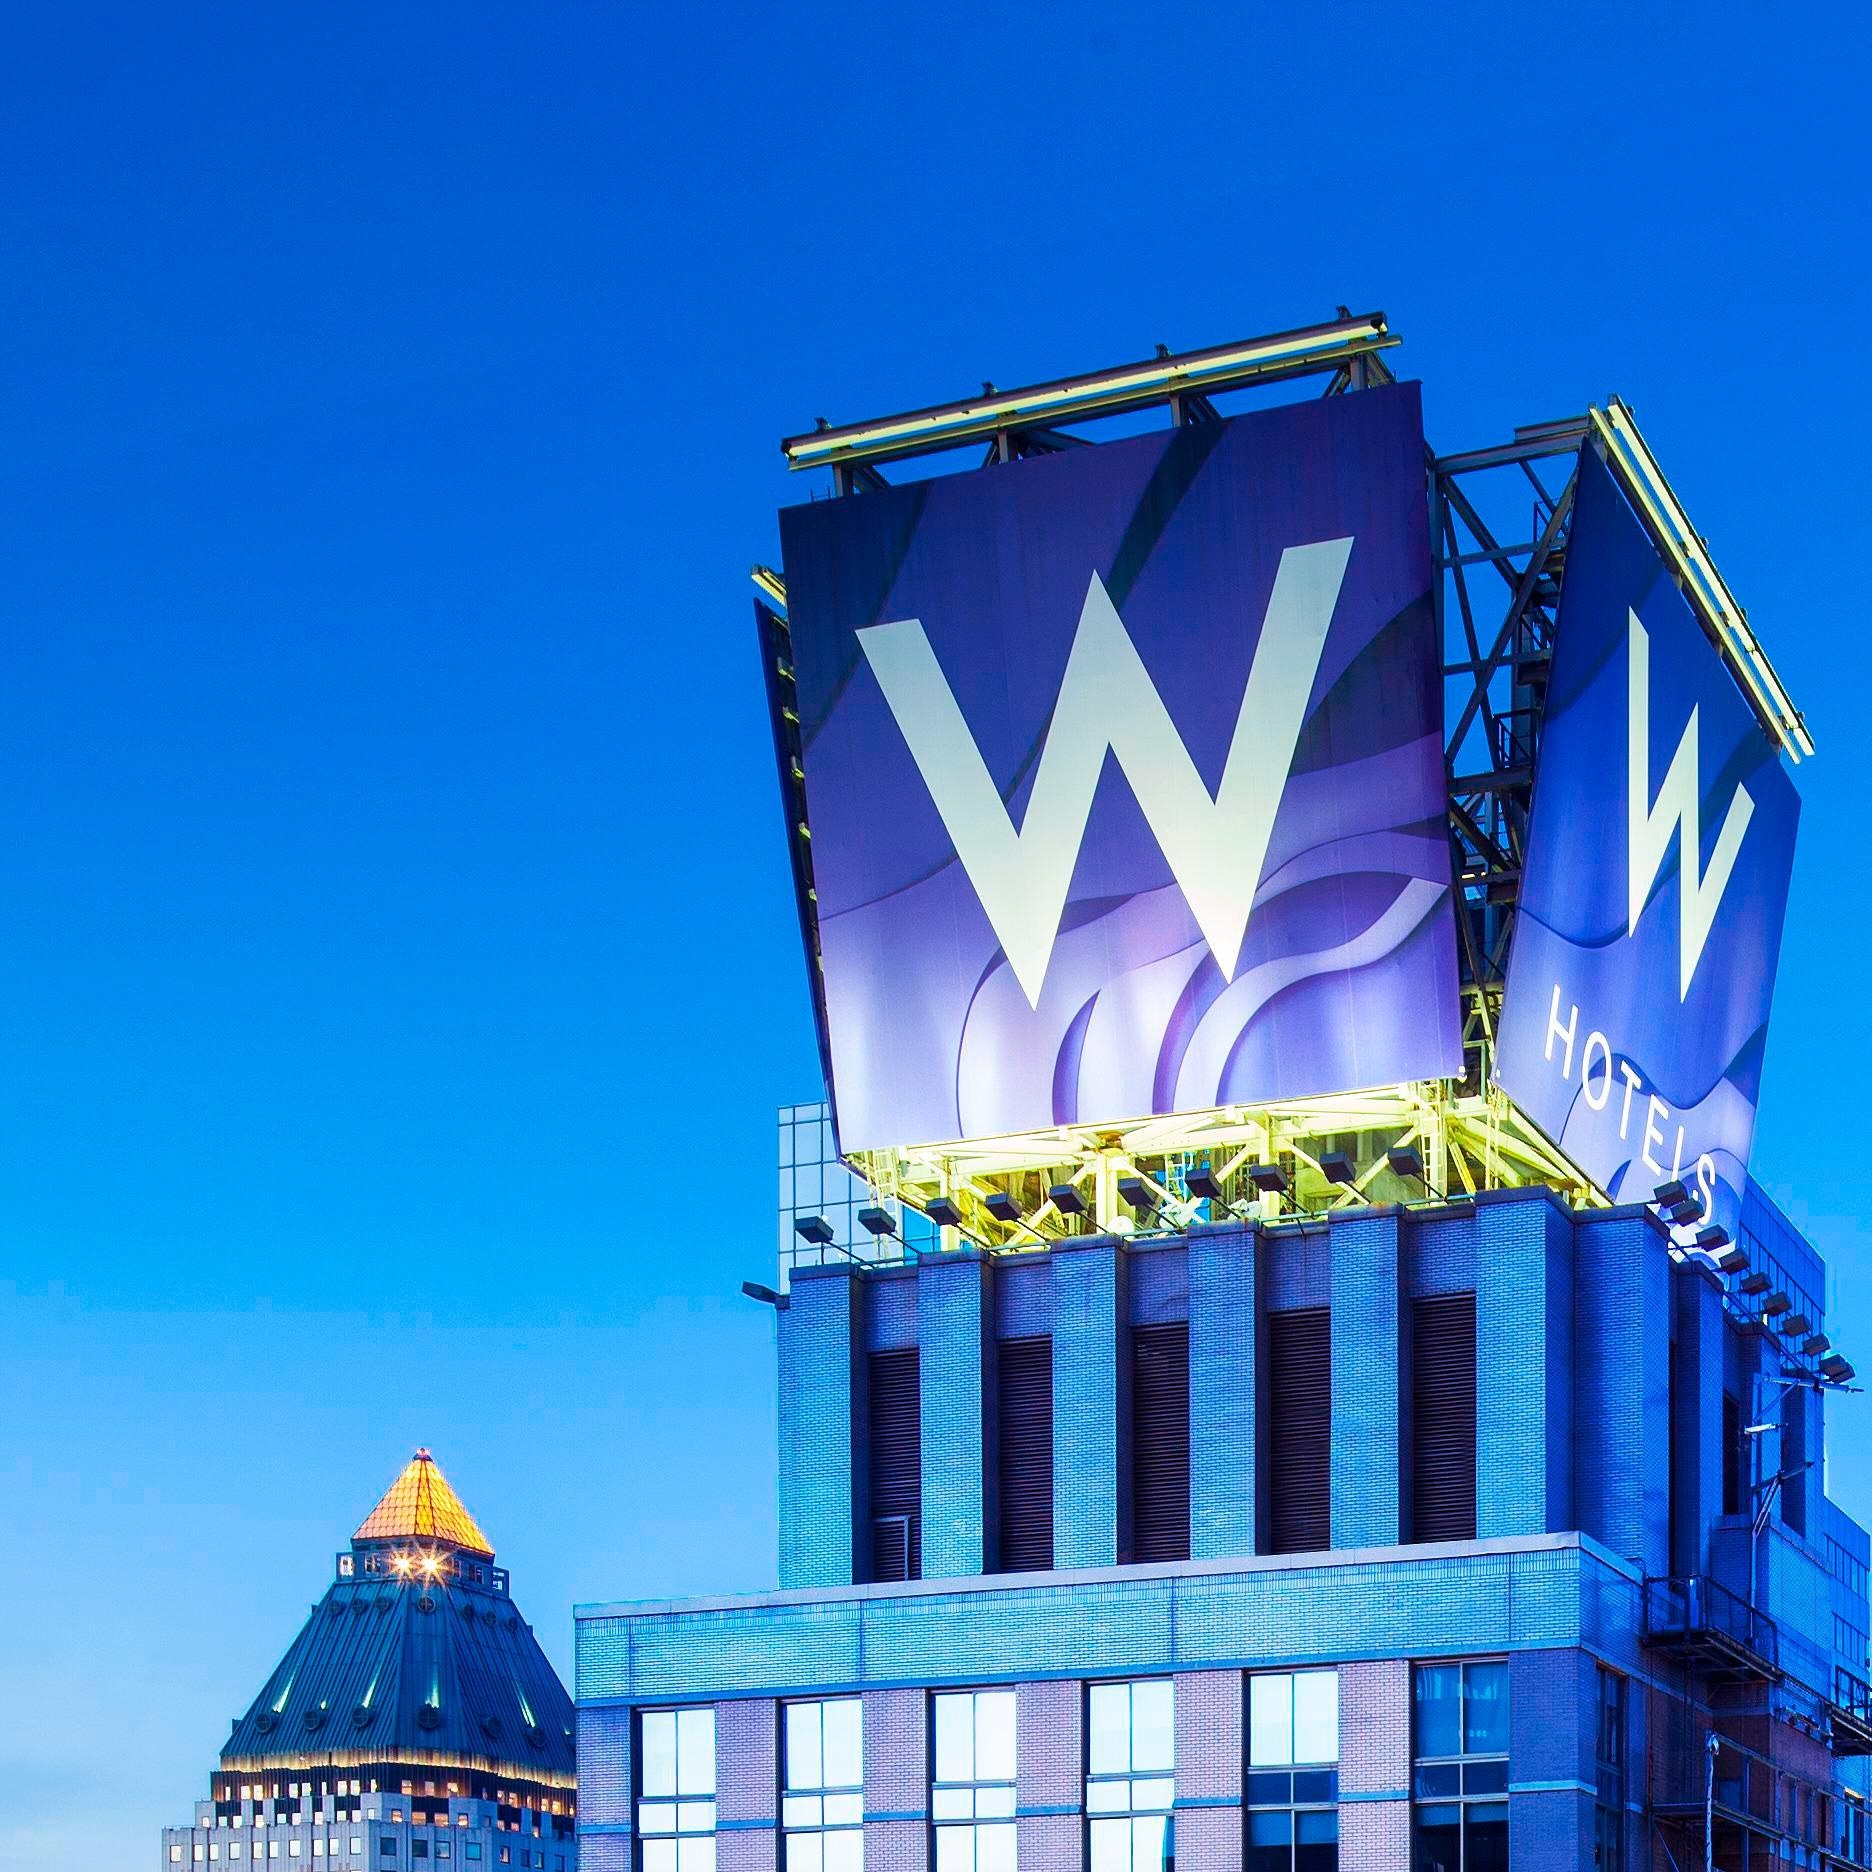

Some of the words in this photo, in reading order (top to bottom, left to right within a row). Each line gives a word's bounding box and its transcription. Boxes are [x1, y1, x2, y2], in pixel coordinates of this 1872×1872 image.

[854, 535, 1354, 1011] W
[1628, 604, 1755, 1004] W
[1544, 983, 1716, 1226] HOTELS
